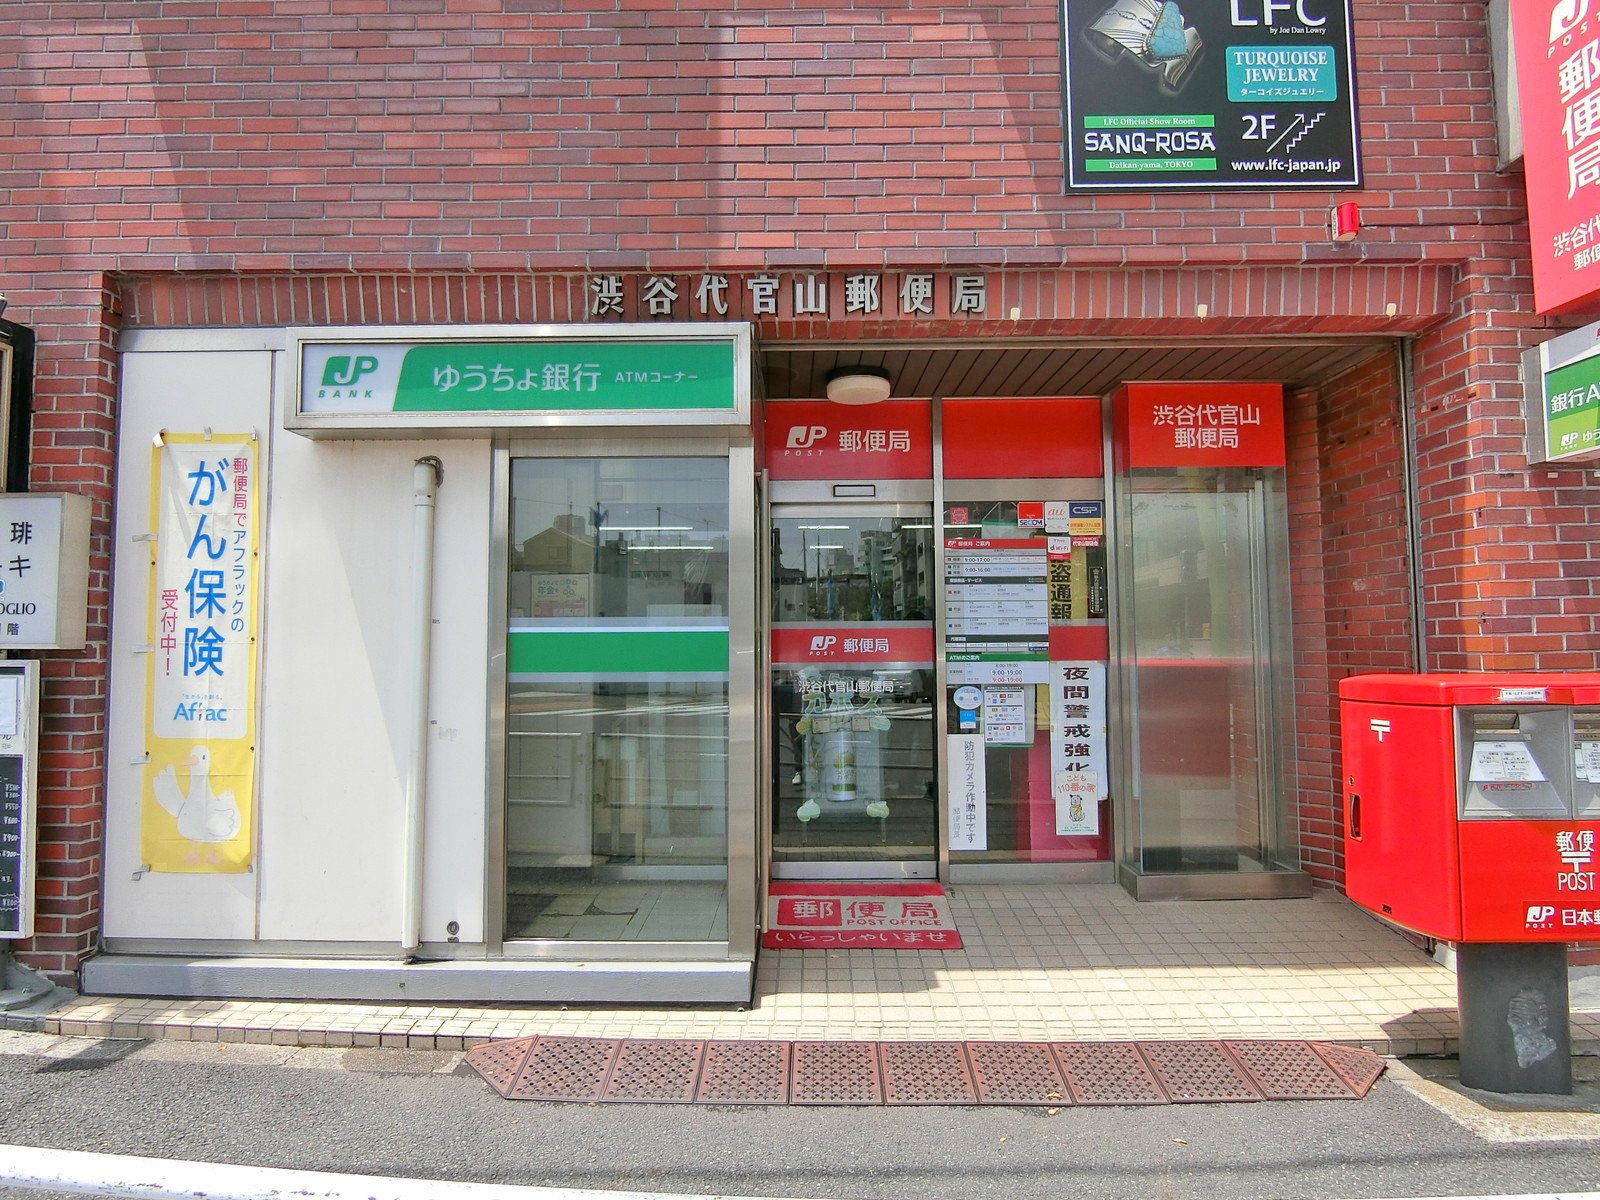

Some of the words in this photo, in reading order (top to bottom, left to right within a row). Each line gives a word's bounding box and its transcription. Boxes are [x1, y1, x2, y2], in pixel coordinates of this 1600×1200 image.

[1231, 0, 1326, 26] LFC
[1269, 26, 1278, 34] by
[1278, 26, 1290, 34] Joe
[1291, 26, 1304, 34] Dan
[1305, 26, 1327, 35] Lowry
[1233, 51, 1328, 67] TURQUOISE
[1243, 68, 1319, 84] JEWELRY
[1241, 87, 1325, 97] ターコイズジュエリー
[1103, 117, 1118, 125] LFC
[1119, 117, 1149, 126] Official
[1150, 117, 1171, 126] Show
[1172, 117, 1196, 126] Room
[1241, 115, 1276, 140] 2F
[1558, 38, 1600, 200] 郵便局
[1084, 131, 1217, 154] SANQ-ROSA
[1165, 161, 1193, 169] TOKYO
[1231, 158, 1341, 174] www.lfc-japan.jp
[590, 273, 987, 316] 渋谷代官山郵便局
[320, 355, 379, 386] JP
[432, 363, 601, 392] ゆうちょ銀行
[614, 370, 699, 384] ATMコーナー
[318, 390, 373, 399] BANK
[1550, 382, 1600, 414] 銀行A
[1152, 403, 1260, 426] 渋谷代官山
[785, 425, 828, 449] JP
[839, 430, 911, 453] 郵便局
[1174, 427, 1239, 449] 郵便局
[784, 449, 824, 457] POST
[1047, 508, 1066, 516] au
[1072, 506, 1098, 514] CSP
[231, 457, 248, 632] 郵便局でアフラックの
[183, 457, 230, 677] がん保険
[810, 635, 837, 651] JP
[843, 638, 889, 653] 郵便局
[798, 680, 894, 693] 渋谷代官山郵便局
[173, 702, 228, 721] Aflac
[1063, 667, 1091, 771] 夜間警戒強化
[964, 740, 976, 844] 防犯カメラ作動中です
[1555, 830, 1595, 852] 郵便
[1557, 872, 1596, 891] POST
[793, 900, 938, 919] 郵便局
[1526, 906, 1555, 923] JP
[775, 931, 947, 943] いらっしゃいませ
